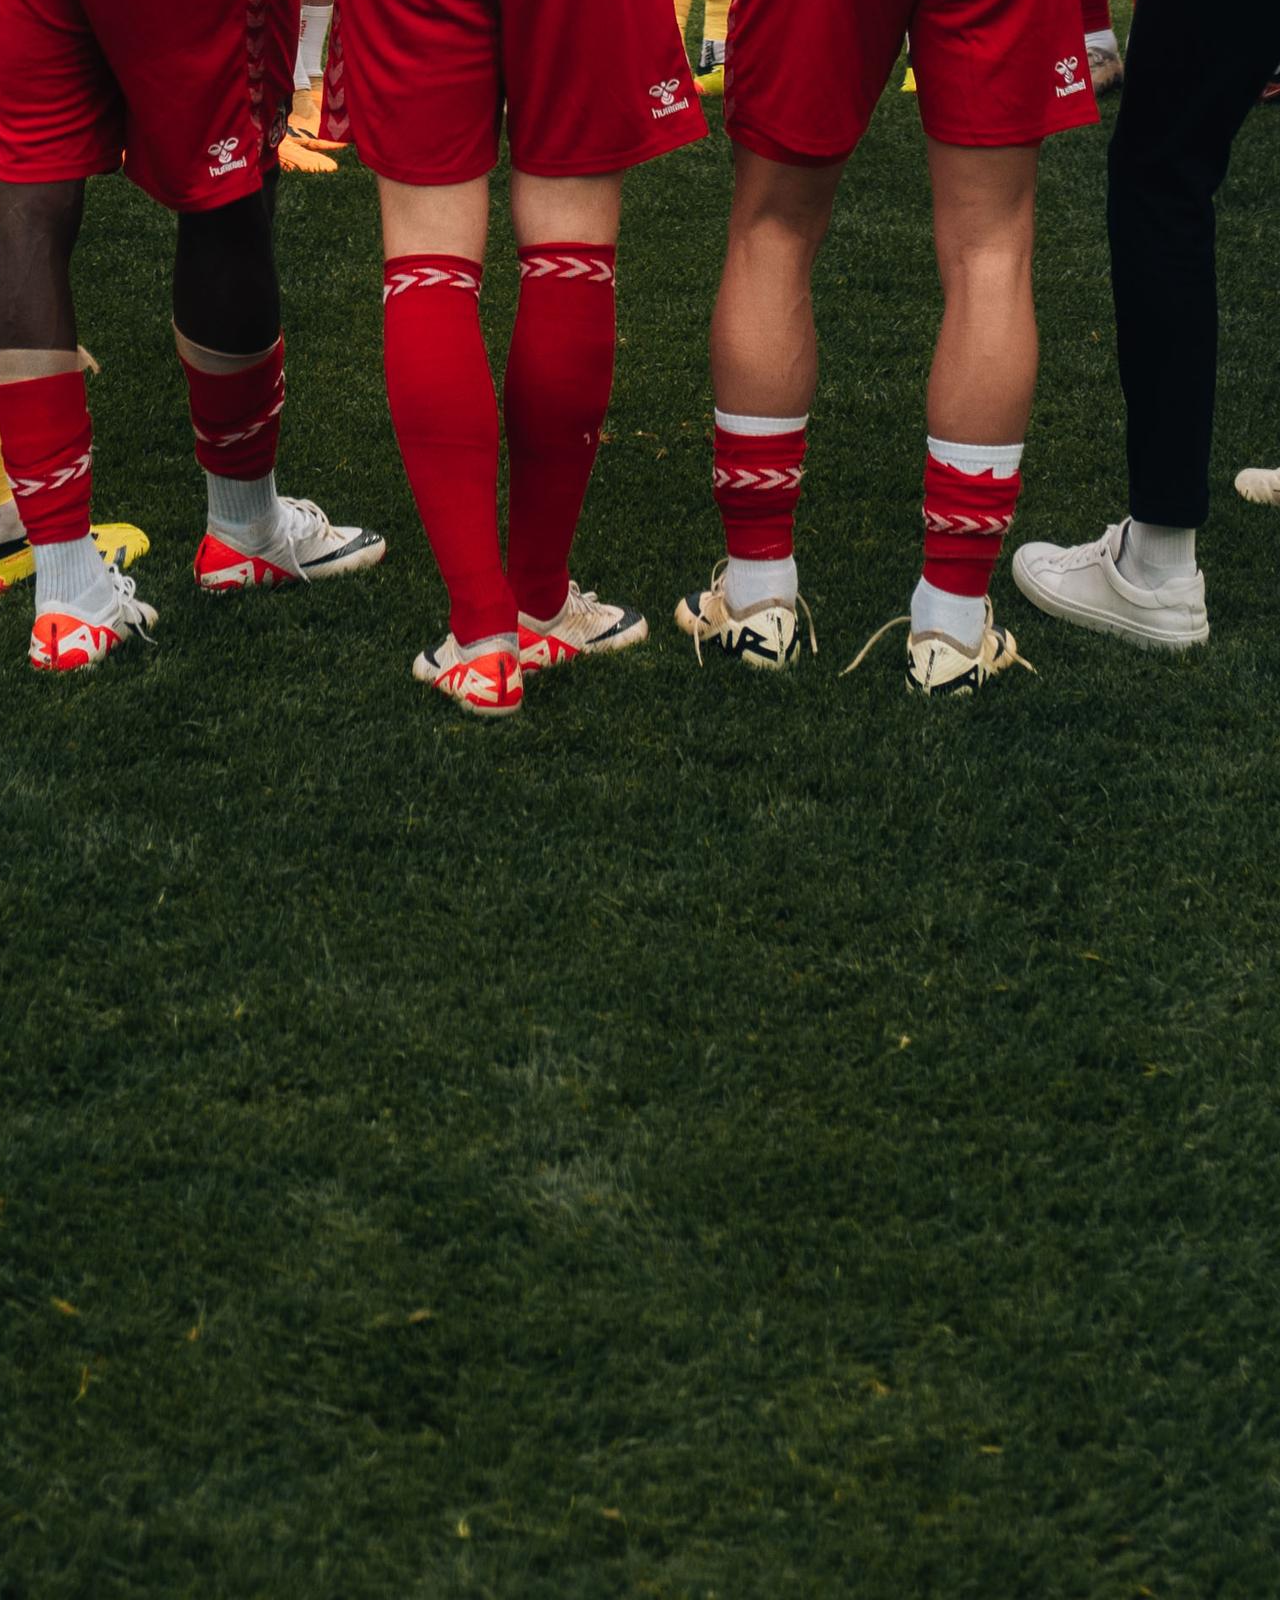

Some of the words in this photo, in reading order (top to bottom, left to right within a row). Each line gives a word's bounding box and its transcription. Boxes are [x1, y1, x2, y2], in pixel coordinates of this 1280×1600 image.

[1056, 77, 1087, 99] hummel
[651, 97, 689, 120] hummel
[208, 155, 248, 178] hummel
